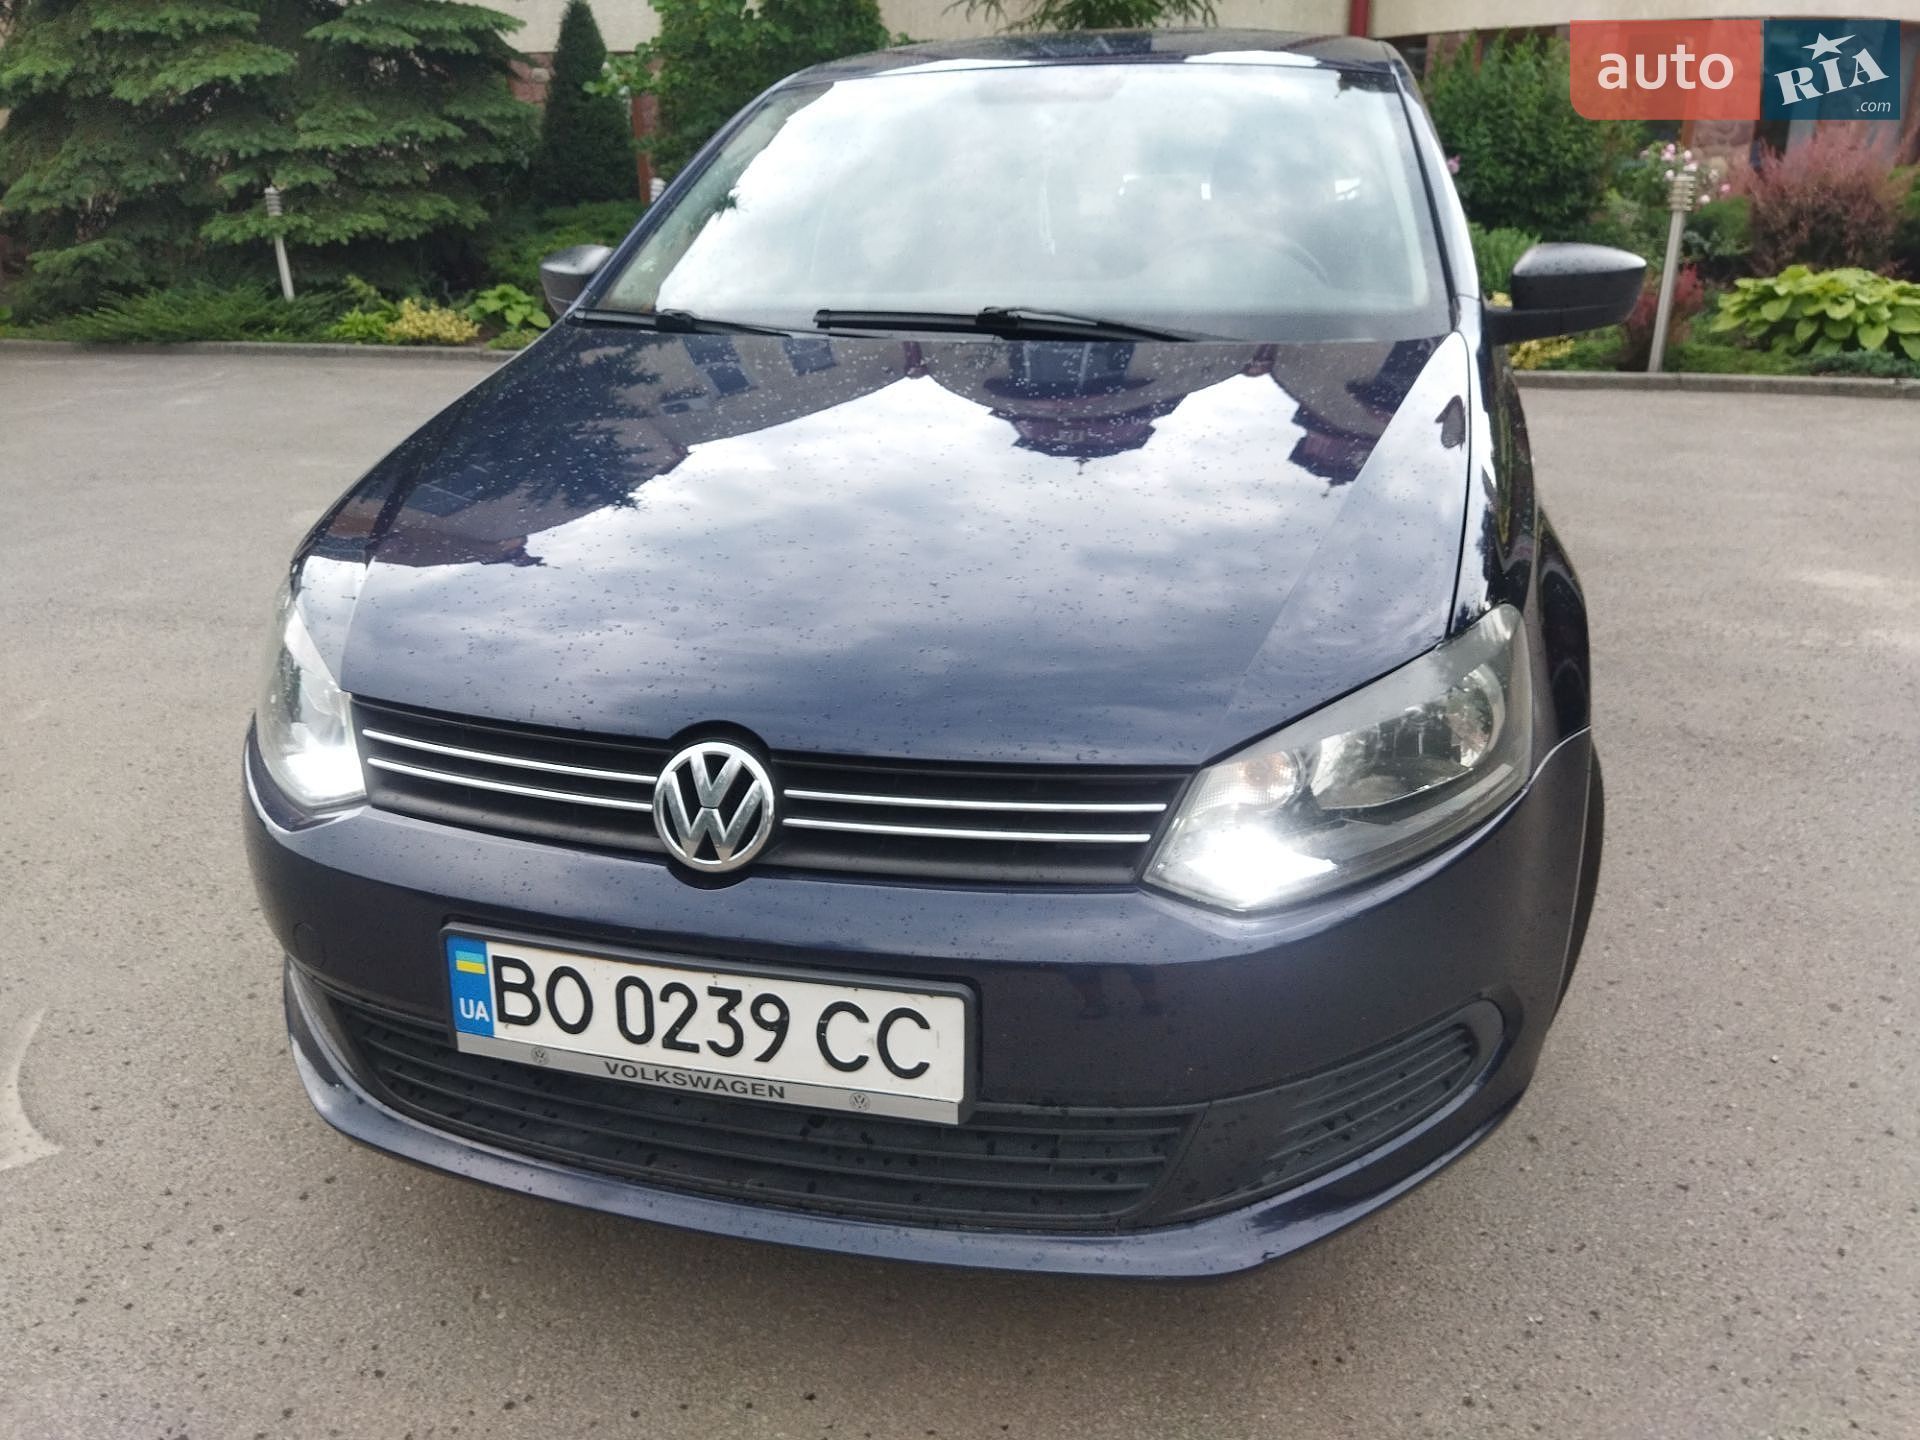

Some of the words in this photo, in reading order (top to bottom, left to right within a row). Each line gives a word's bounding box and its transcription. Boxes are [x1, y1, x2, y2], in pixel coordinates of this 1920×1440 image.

[459, 998, 490, 1023] UA
[492, 955, 594, 1035] BO
[615, 975, 790, 1063] 0239
[815, 1001, 932, 1080] CC
[603, 1061, 786, 1100] VOLKSWAGEN
